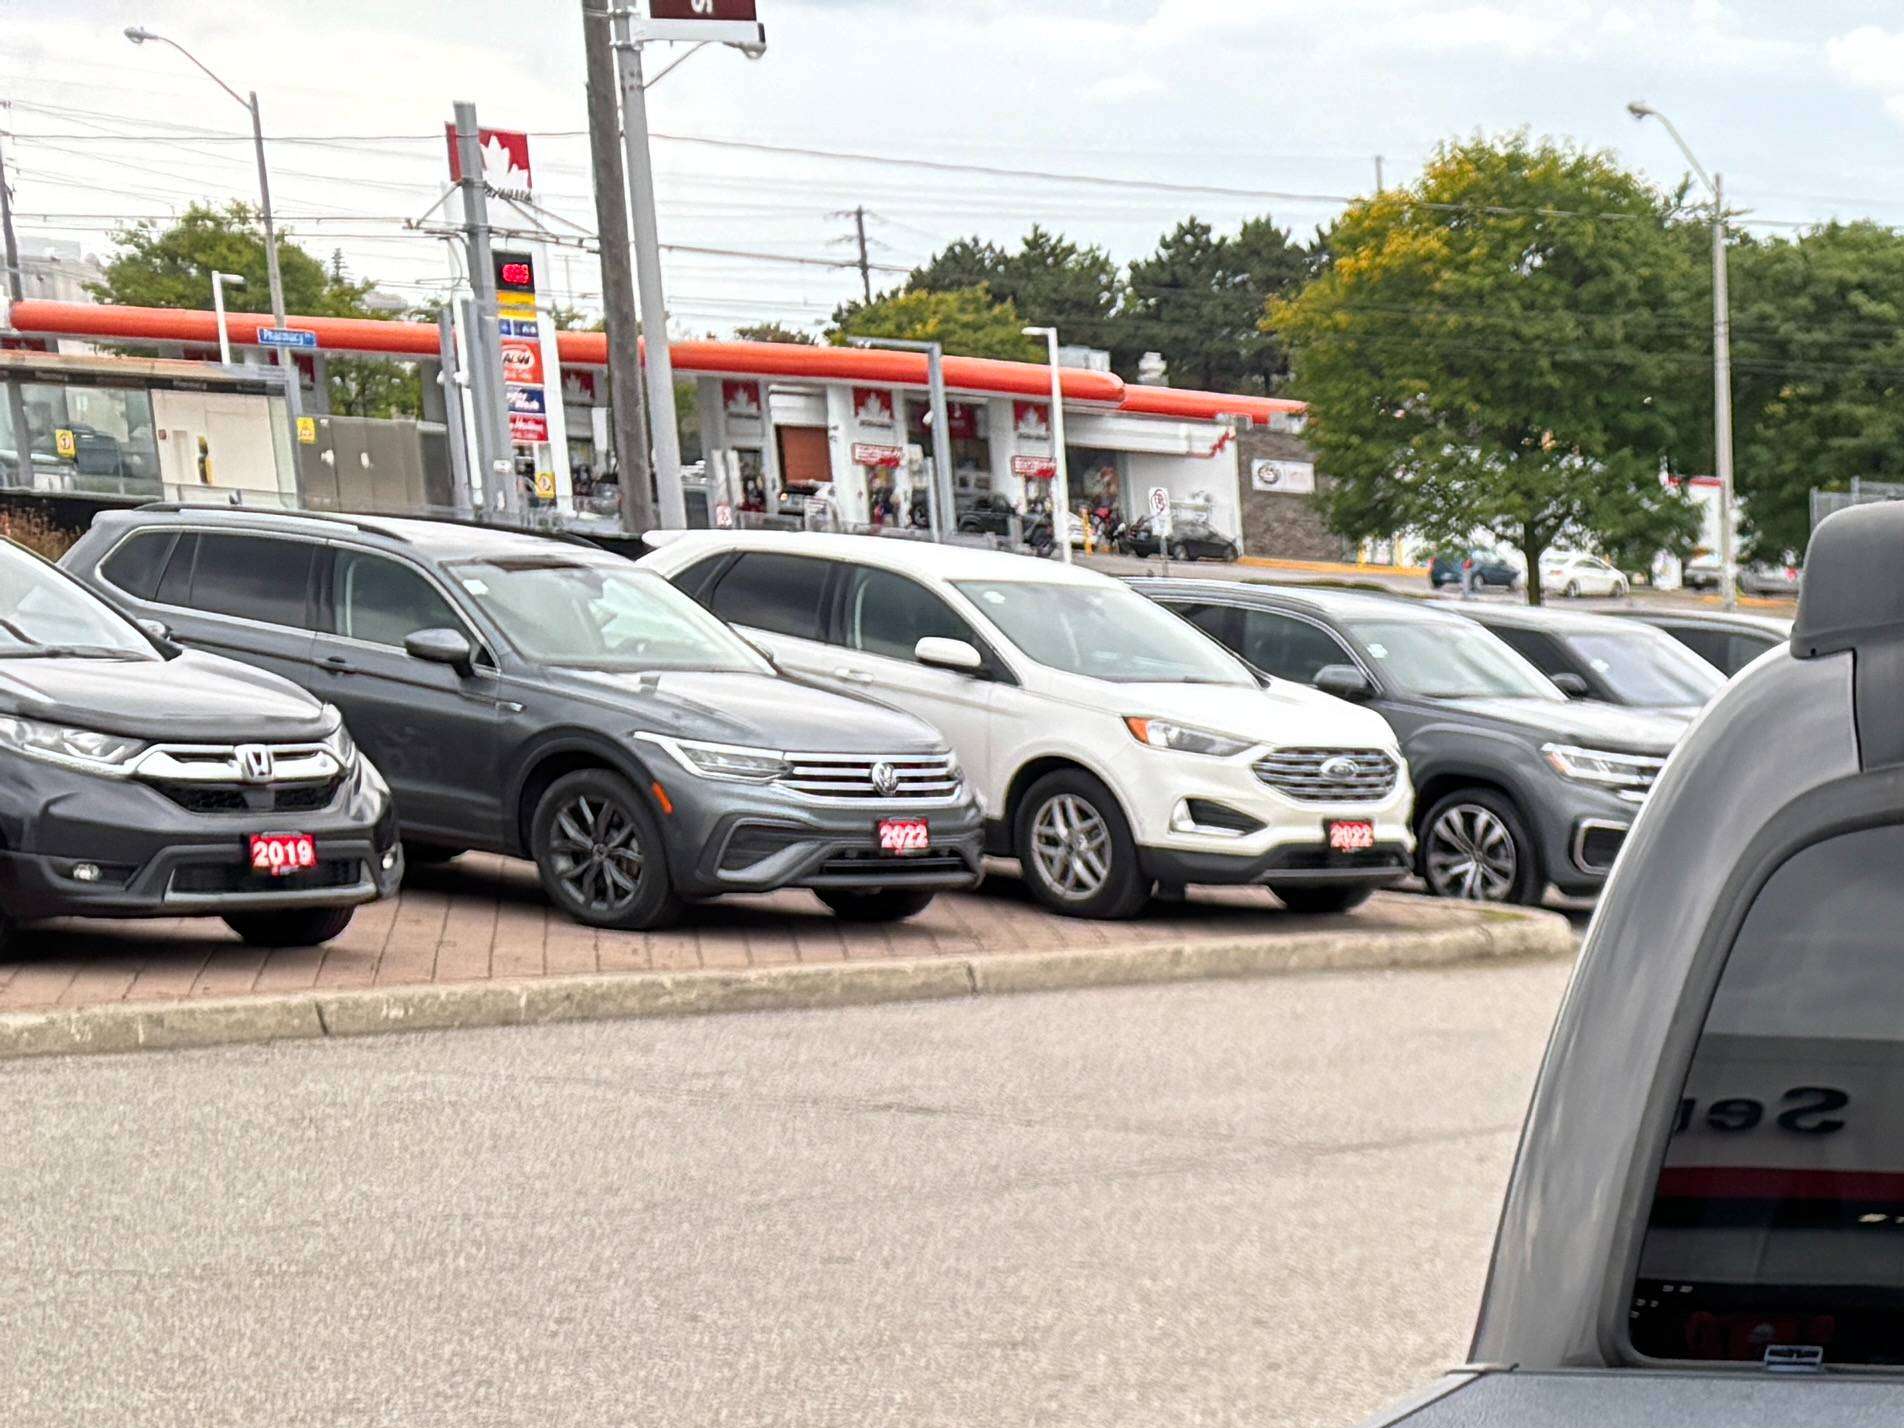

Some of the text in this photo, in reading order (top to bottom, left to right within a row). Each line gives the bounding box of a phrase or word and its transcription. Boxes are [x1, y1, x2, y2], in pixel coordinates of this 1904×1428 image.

[879, 824, 929, 849] 2022
[1330, 823, 1374, 848] 2022
[253, 840, 313, 867] 2019
